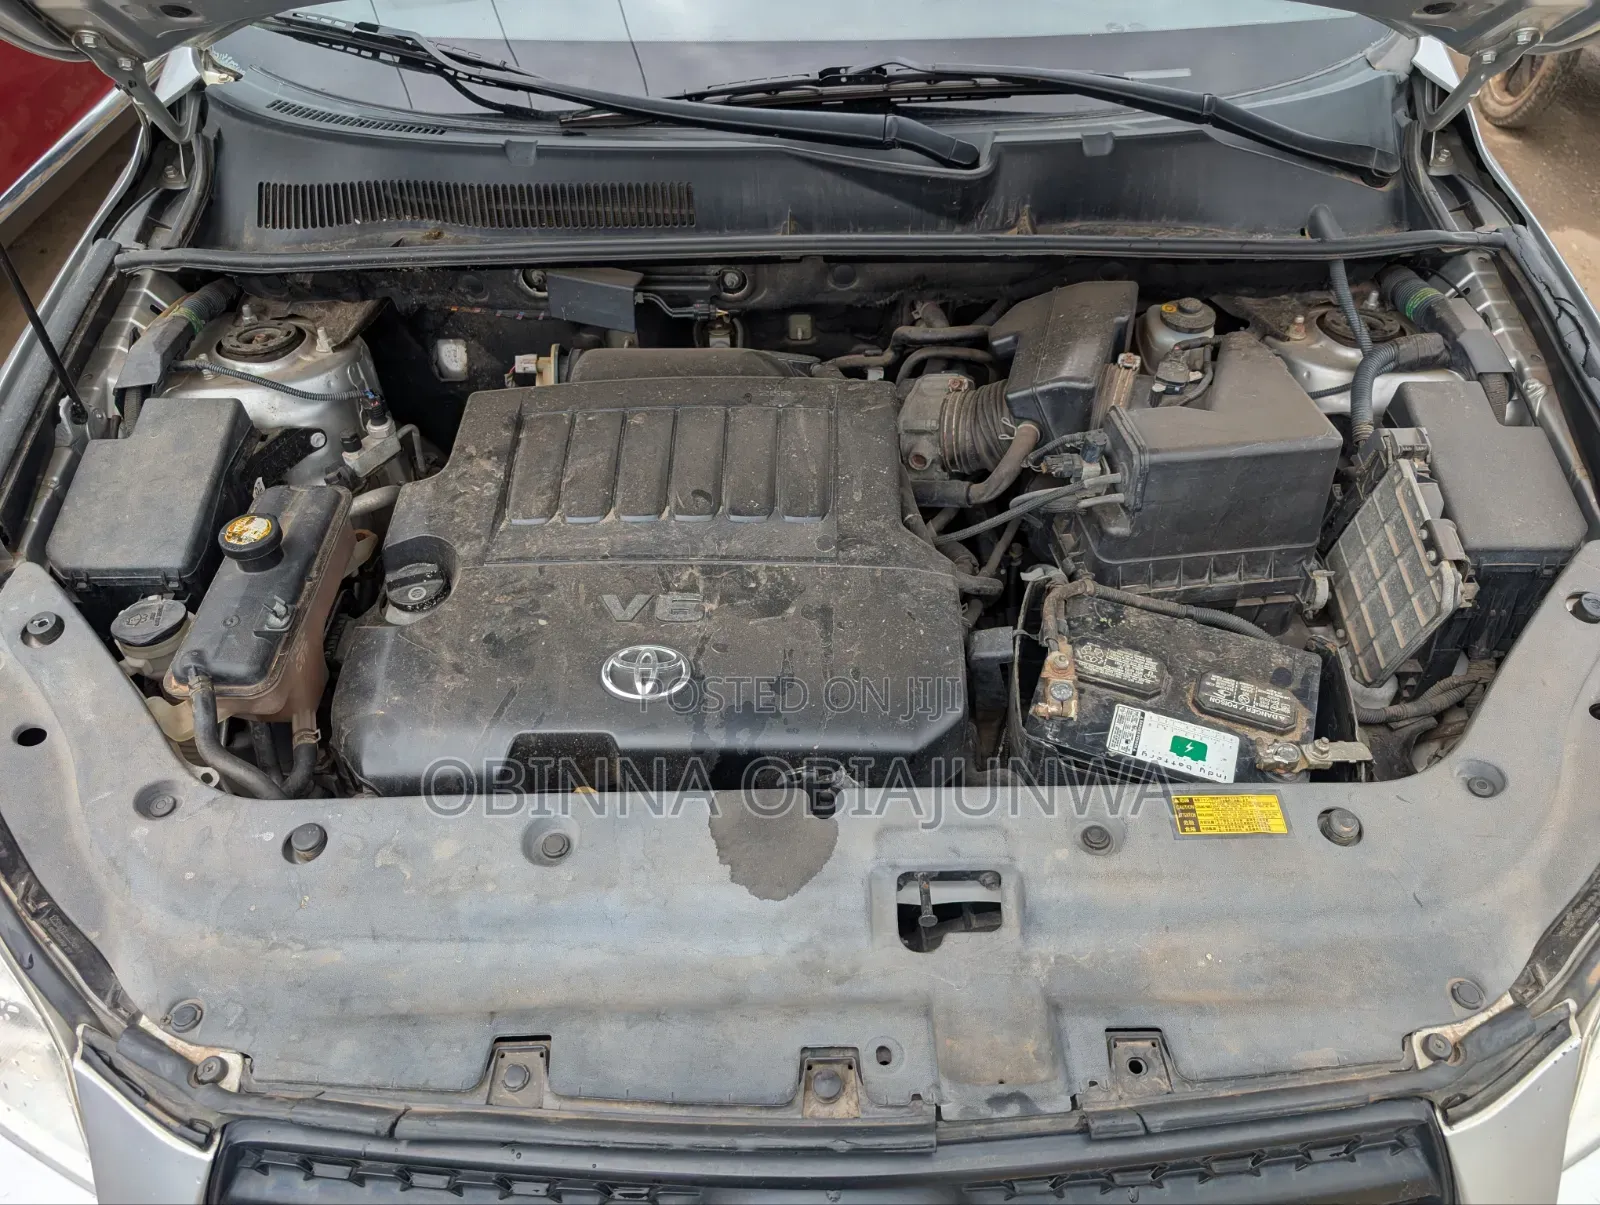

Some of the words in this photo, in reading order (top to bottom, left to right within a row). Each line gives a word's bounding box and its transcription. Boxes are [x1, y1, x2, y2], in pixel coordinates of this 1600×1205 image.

[600, 593, 705, 622] V6
[1209, 696, 1238, 709] POISON
[1246, 706, 1278, 720] DANGER
[1141, 750, 1192, 771] battery
